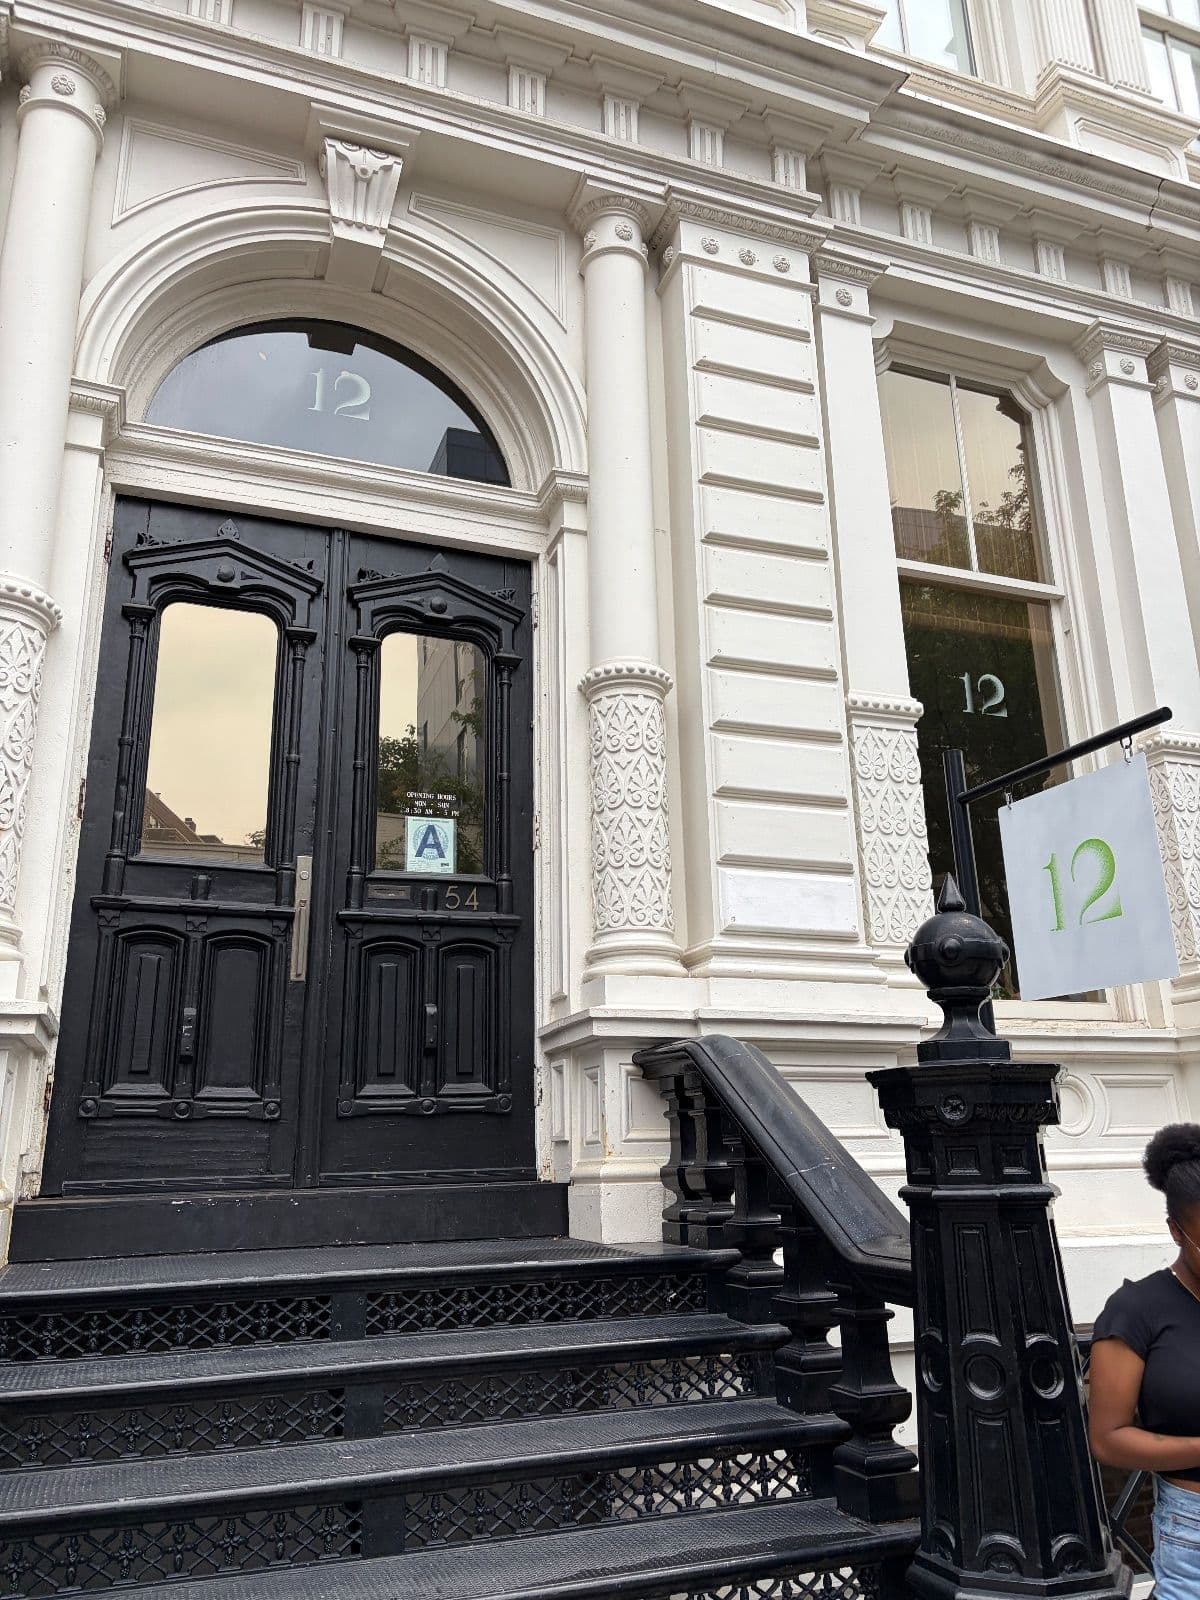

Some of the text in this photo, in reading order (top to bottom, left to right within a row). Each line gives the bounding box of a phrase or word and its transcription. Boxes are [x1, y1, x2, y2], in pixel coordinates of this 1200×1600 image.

[307, 368, 371, 421] 12
[959, 672, 1008, 718] 12
[406, 791, 457, 801] OPENING HOURS
[415, 824, 445, 858] A
[445, 885, 480, 911] 54
[1041, 838, 1123, 932] 12
